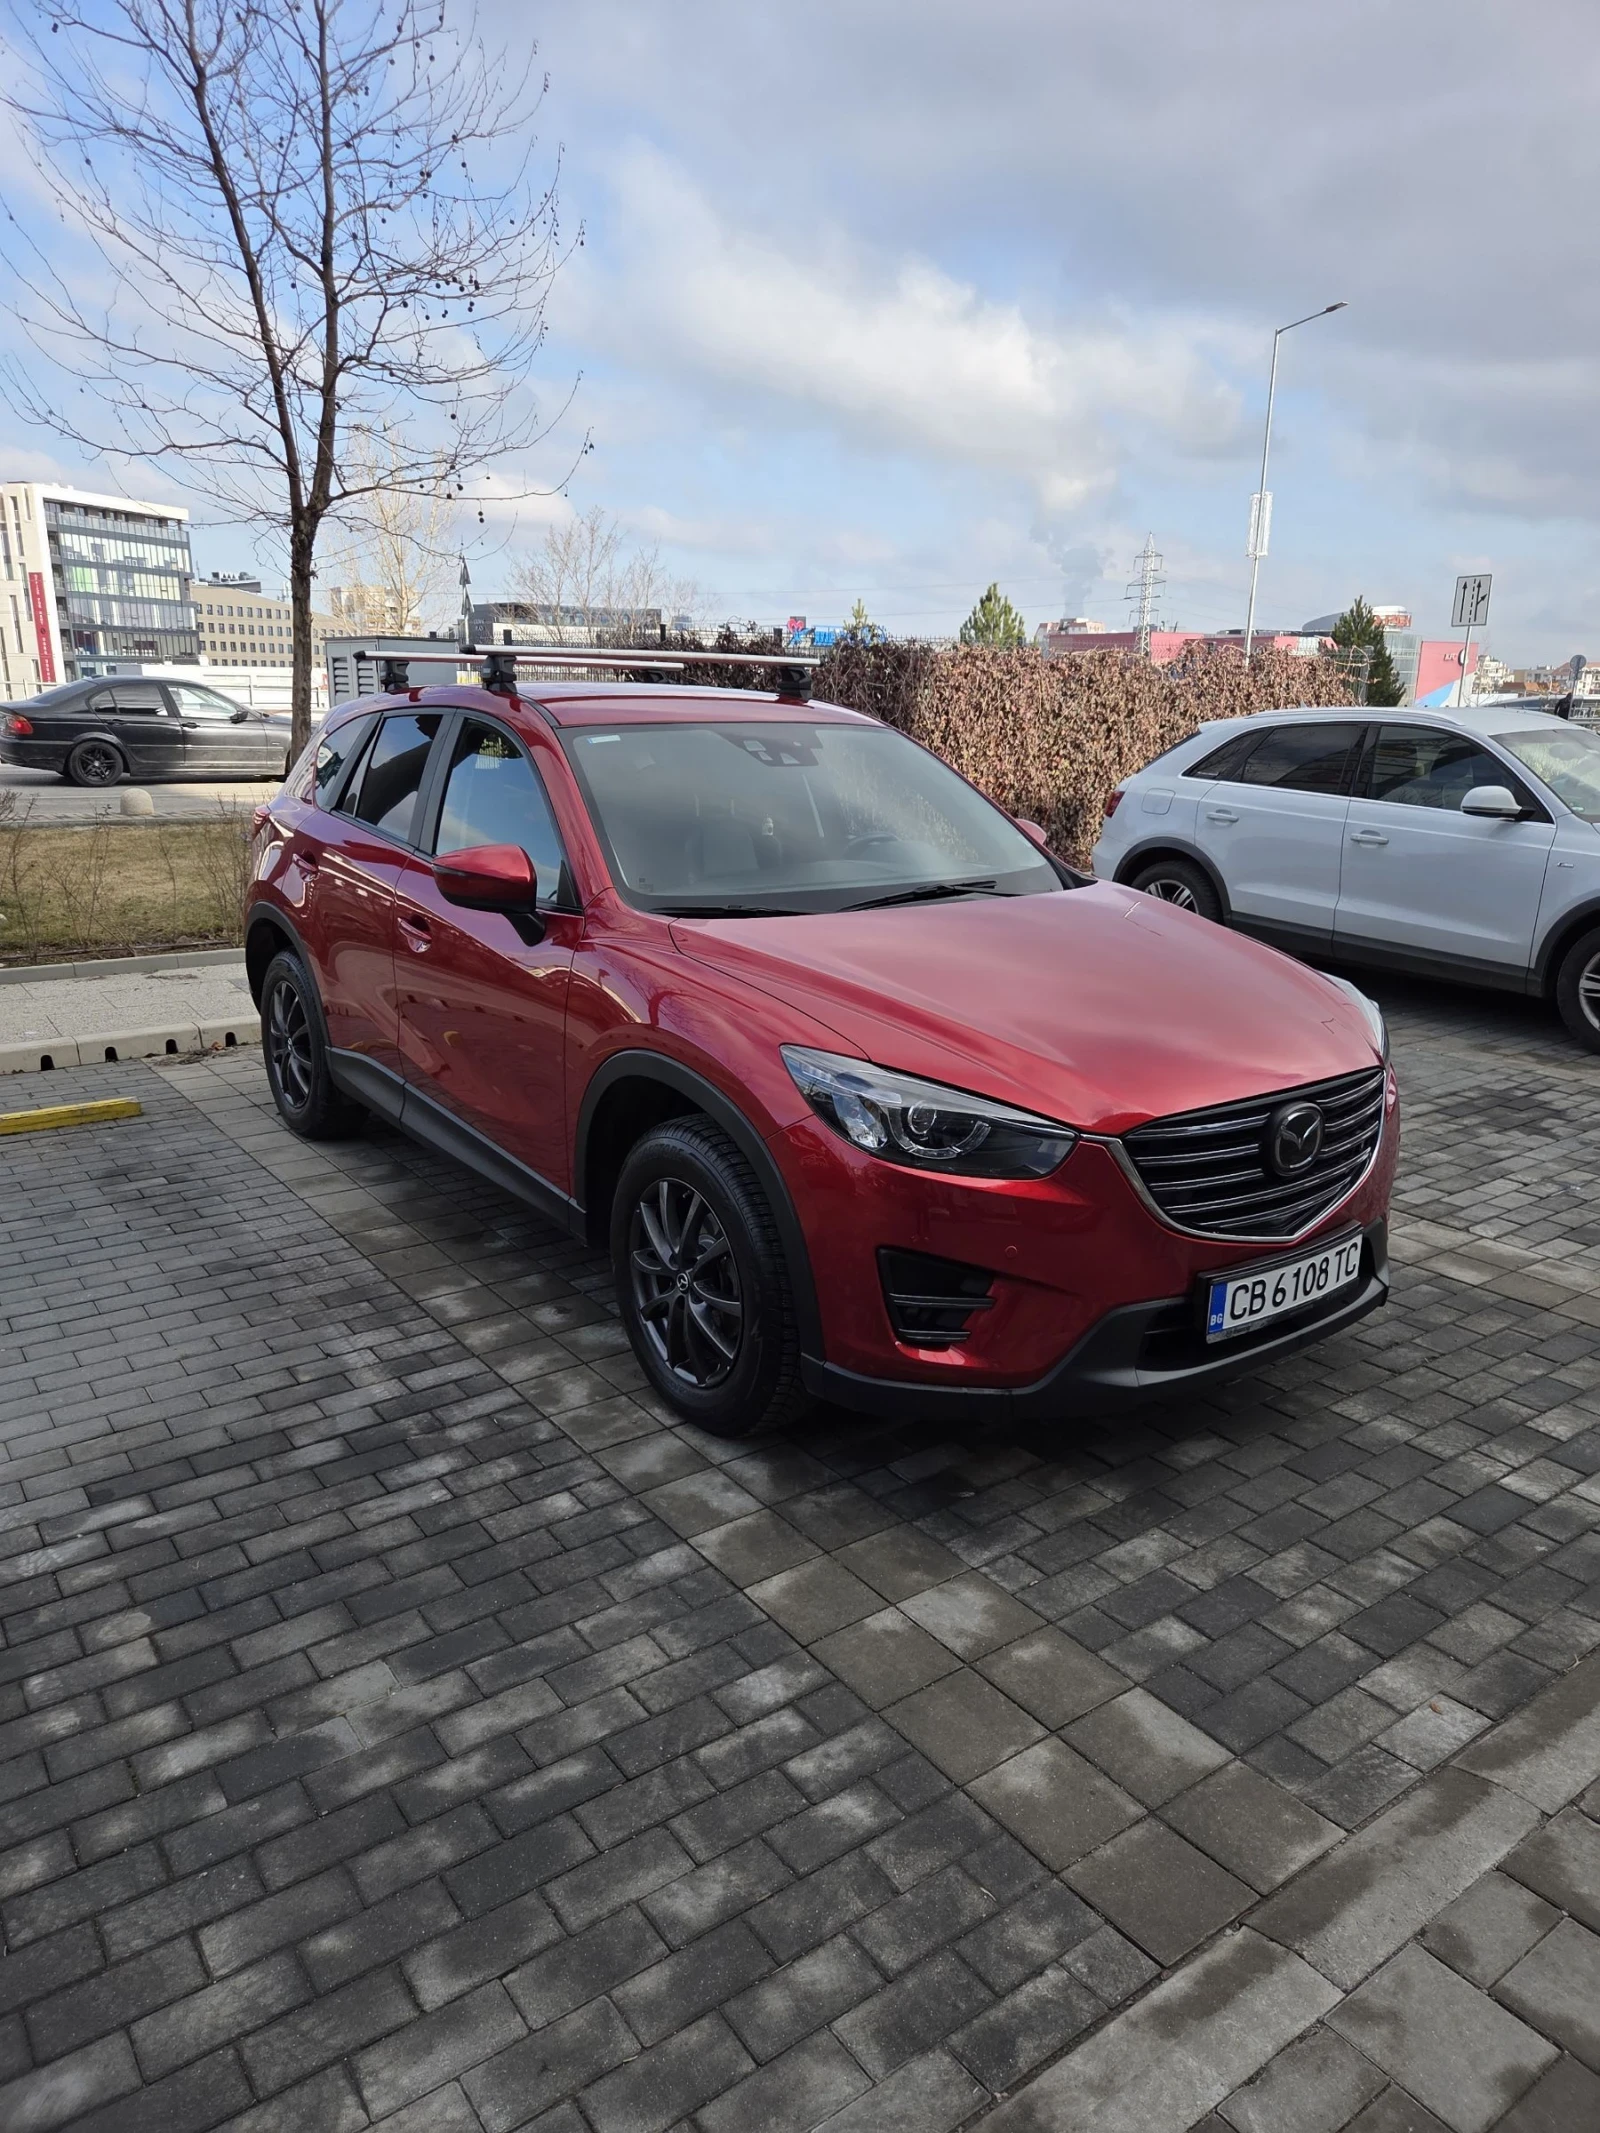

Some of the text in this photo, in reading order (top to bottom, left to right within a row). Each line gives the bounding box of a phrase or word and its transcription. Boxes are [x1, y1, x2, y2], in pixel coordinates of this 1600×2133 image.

[1230, 1242, 1358, 1320] CB 6108 TC
[1210, 1313, 1223, 1326] BG
